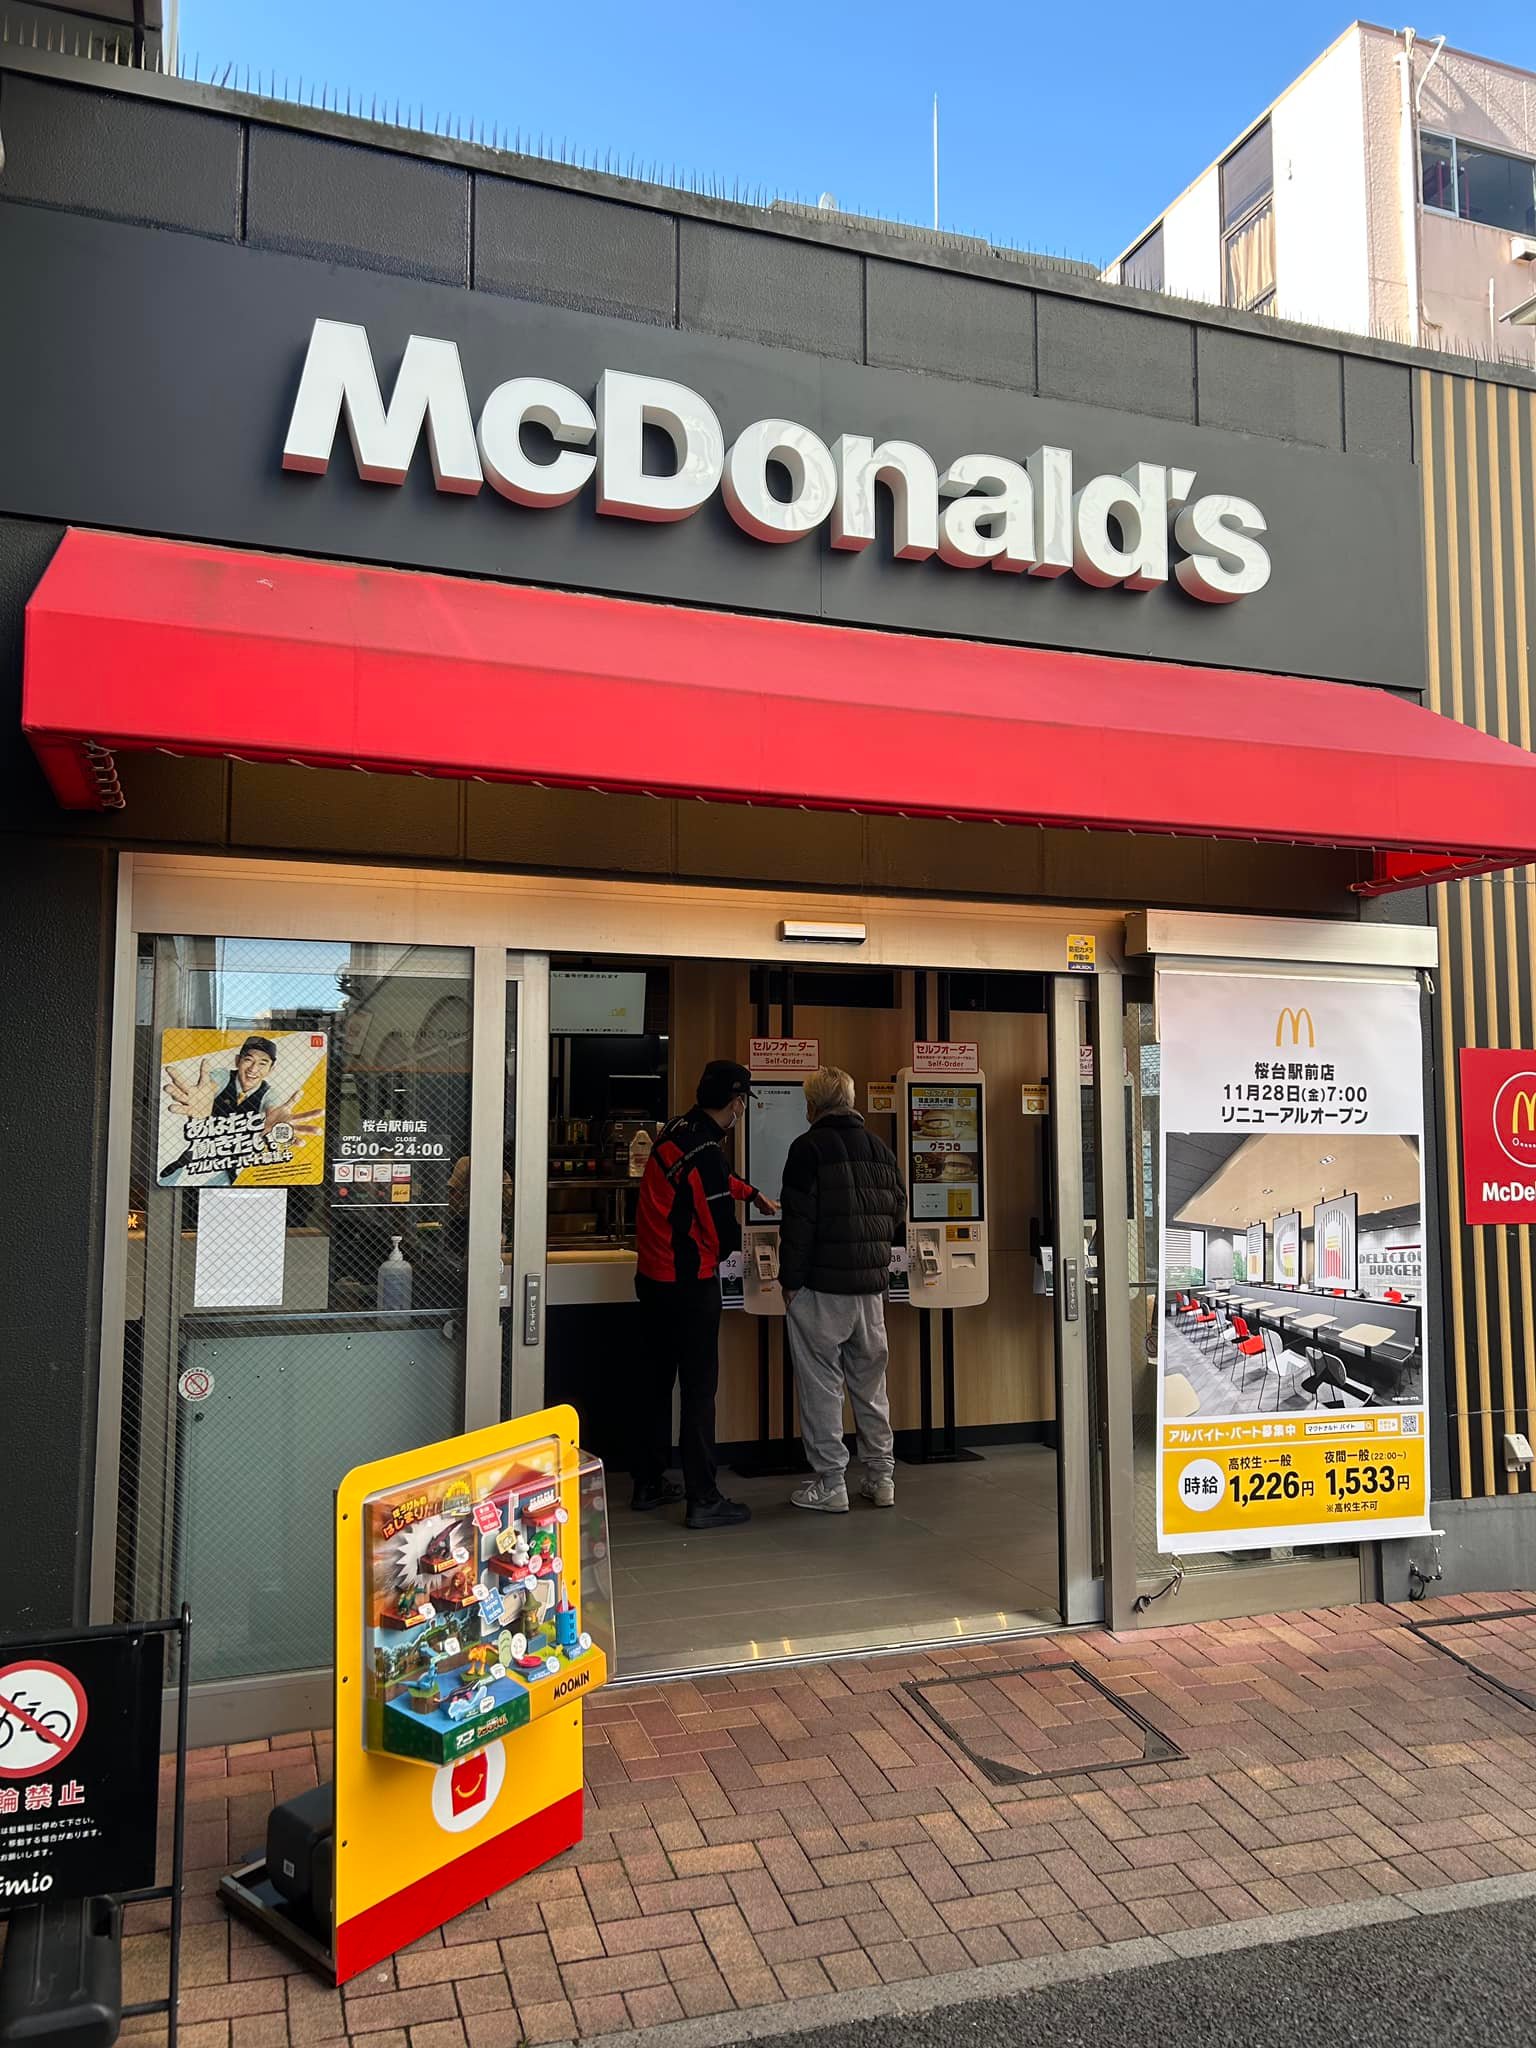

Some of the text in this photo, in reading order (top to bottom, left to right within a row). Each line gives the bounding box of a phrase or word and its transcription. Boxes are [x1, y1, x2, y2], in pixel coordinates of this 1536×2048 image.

[283, 318, 1273, 605] McDonald's
[753, 1041, 816, 1052] セルフオーダー
[917, 1045, 975, 1055] セルフオーダー
[1254, 1061, 1335, 1081] 桜台駅前店
[185, 1111, 267, 1140] あなたと
[1221, 1106, 1369, 1125] リニューアルオープン
[362, 1119, 428, 1133] 桜台駅前店
[1168, 1424, 1297, 1443] アルバイト・パート募集中
[1228, 1454, 1292, 1471] 高校生・一般
[1184, 1475, 1219, 1495] 時給
[1229, 1471, 1314, 1507] 1,226円
[1325, 1465, 1410, 1500] 1,533円
[553, 1670, 590, 1701] MOOMIN
